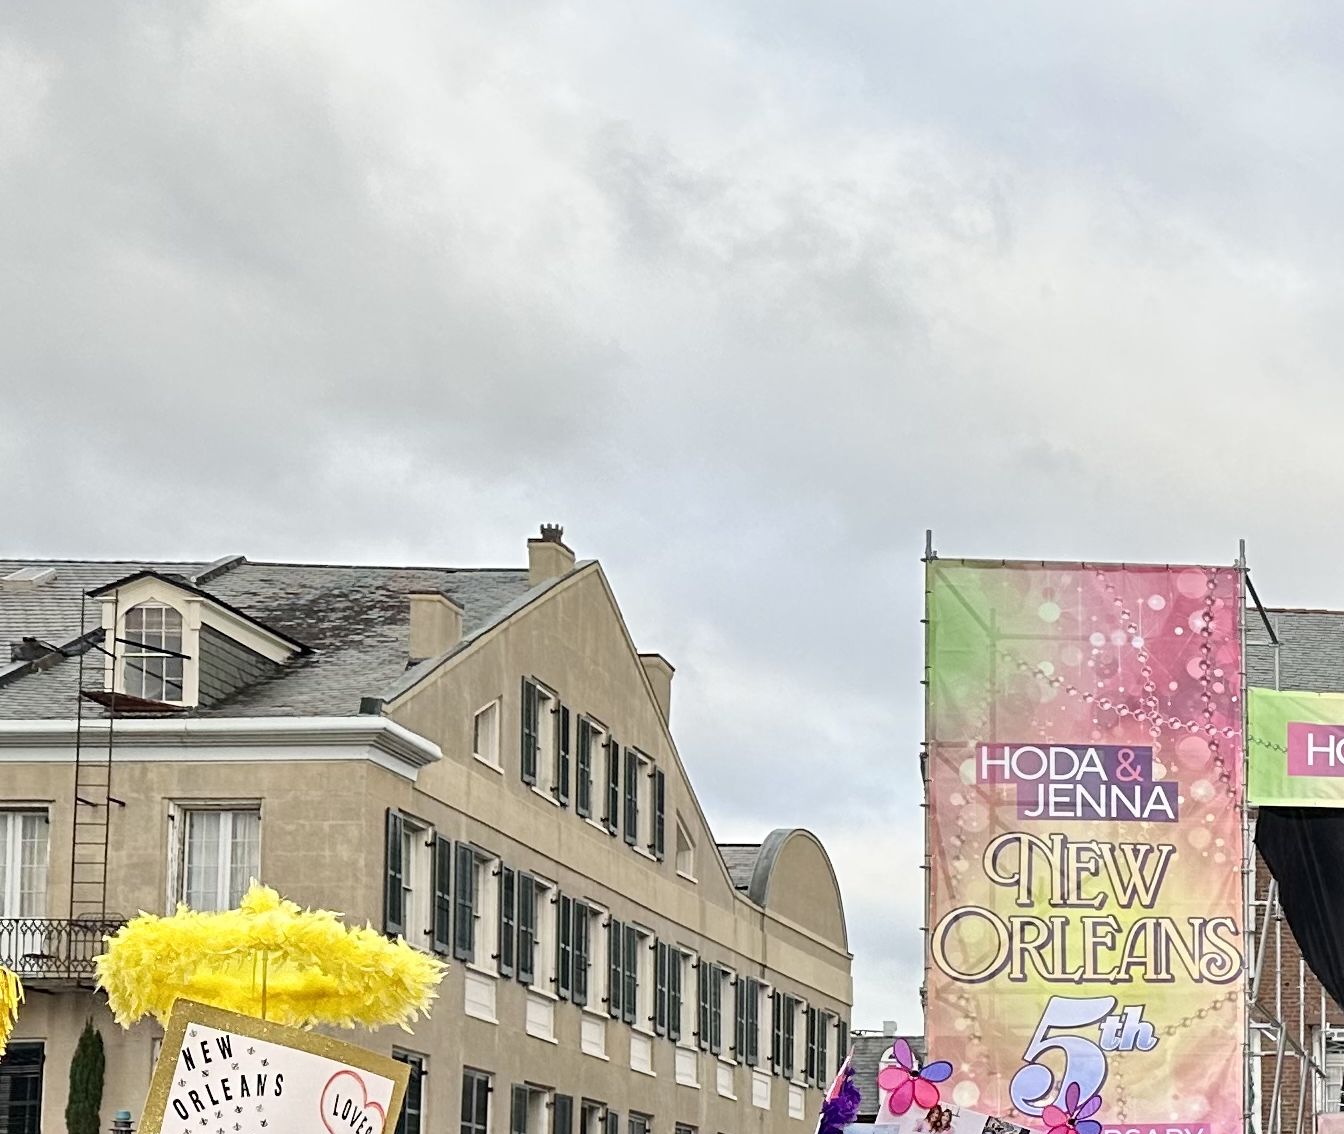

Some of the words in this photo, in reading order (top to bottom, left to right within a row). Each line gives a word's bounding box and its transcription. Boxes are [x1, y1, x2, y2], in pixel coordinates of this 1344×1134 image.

[981, 746, 1108, 781] HODA
[1116, 749, 1143, 782] &
[1023, 783, 1175, 819] JENNA
[982, 831, 1176, 909] NEW
[931, 906, 1244, 984] ORLEANS
[182, 1034, 233, 1071] NEW
[1009, 995, 1160, 1117] 5th
[172, 1073, 284, 1121] ORLEANS
